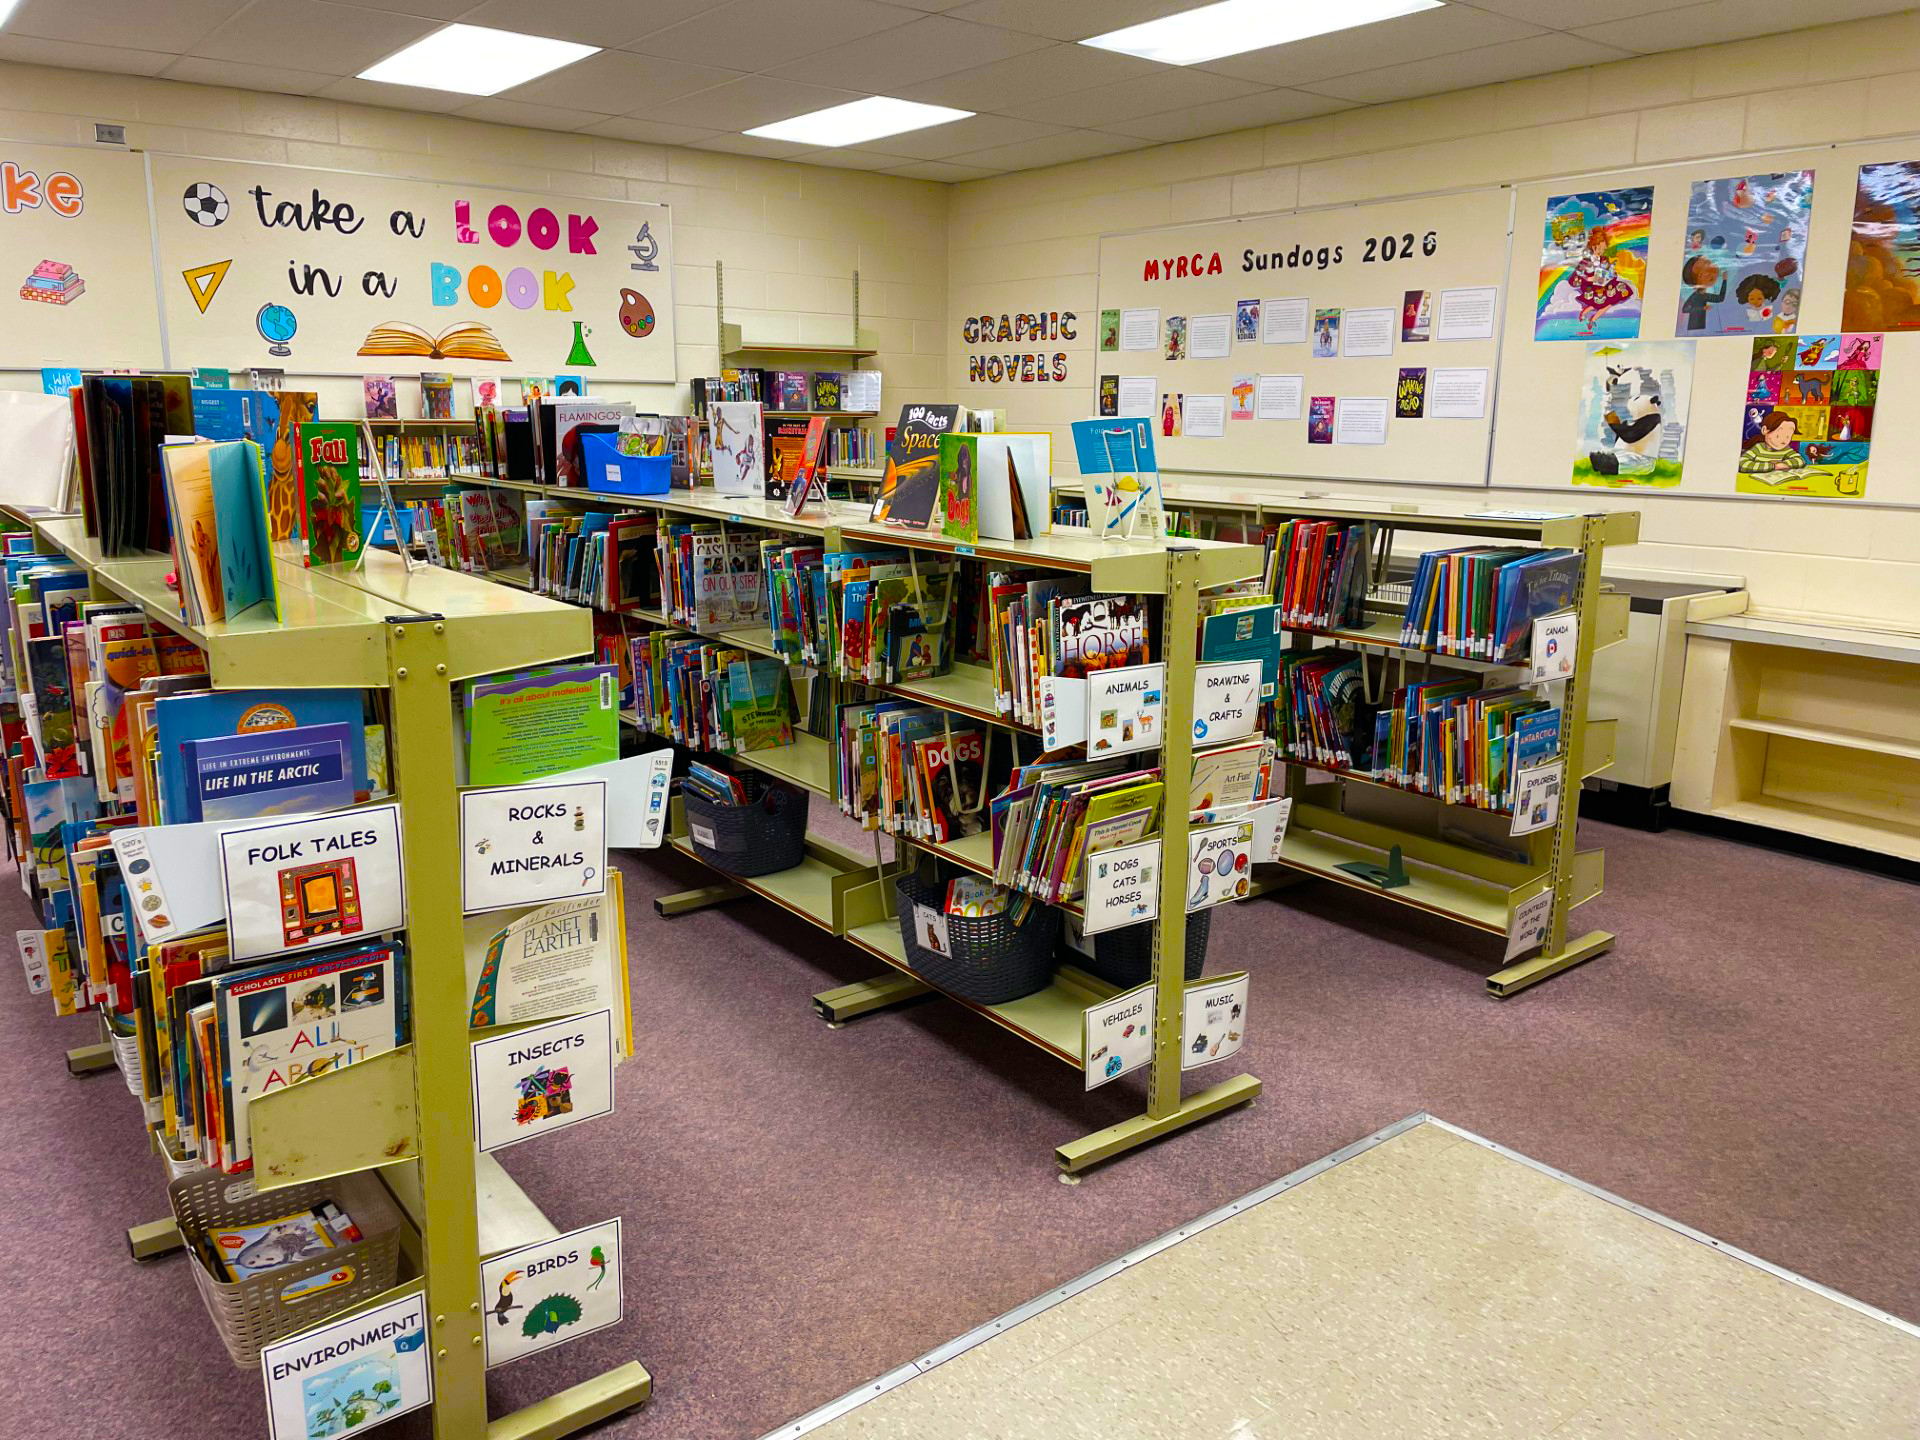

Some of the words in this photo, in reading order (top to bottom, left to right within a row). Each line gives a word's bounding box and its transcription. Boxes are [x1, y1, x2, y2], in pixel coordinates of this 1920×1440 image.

[249, 183, 364, 236] take
[390, 205, 426, 239] a
[455, 200, 600, 255] LOOK
[1144, 252, 1223, 281] MYRCA
[1243, 240, 1344, 274] Sundogs
[1363, 231, 1438, 263] 2026
[288, 258, 342, 298] in
[363, 265, 397, 298] a
[431, 262, 575, 312] BOOK
[964, 311, 1078, 344] GRAPHIC
[969, 352, 1068, 383] NOVELS
[52, 372, 73, 385] WAR
[367, 381, 393, 390] SHURI
[48, 383, 69, 396] STOR
[559, 411, 622, 422] FLAMINGOS
[909, 407, 925, 420] 100
[926, 411, 948, 428] facts
[901, 425, 940, 454] Space
[309, 436, 349, 464] Fall
[947, 488, 970, 529] Dogs
[702, 577, 716, 592] ON
[719, 575, 737, 591] OUR
[1073, 594, 1102, 603] EYEWITNESS
[1546, 626, 1568, 636] CANADA
[1063, 626, 1142, 665] HORSE
[137, 655, 203, 672] scence
[1106, 680, 1149, 695] ANIMALS
[1207, 674, 1250, 688] DRAWING
[514, 696, 523, 704] all
[526, 692, 550, 702] about
[1225, 693, 1231, 703] &
[1209, 709, 1243, 722] CRAFTS
[1520, 728, 1556, 744] ANTARCTICA
[203, 762, 216, 771] LIFE
[230, 756, 259, 767] EXTREME
[261, 749, 311, 763] ENVIRONMENTS
[928, 740, 981, 768] DOGS
[205, 776, 229, 791] LIFE
[233, 774, 247, 787] IN
[251, 770, 274, 784] THE
[277, 763, 320, 780] ARCTIC
[1224, 775, 1235, 783] Art
[1527, 774, 1557, 788] EXPLORERS
[508, 804, 567, 822] ROCKS
[532, 830, 544, 845] &
[1207, 836, 1237, 851] SPORTS
[248, 842, 303, 865] FOLK
[310, 830, 378, 853] TALES
[490, 852, 584, 876] MINERALS
[1113, 858, 1139, 872] DOGS
[1112, 876, 1137, 889] CATS
[965, 890, 984, 899] Book
[1105, 891, 1142, 908] HORSES
[545, 898, 600, 917] Factfinder
[1519, 900, 1548, 920] COUNTRIES
[923, 912, 937, 922] CATS
[1522, 920, 1528, 929] OF
[1530, 914, 1541, 924] THE
[524, 915, 582, 944] PLANET
[1520, 927, 1537, 941] WORLD
[522, 928, 582, 959] EARTH
[233, 976, 285, 993] SCHOLASTIC
[288, 968, 314, 981] FIRST
[317, 953, 386, 974] ENCYCLOPEDIA
[1205, 994, 1234, 1008] MUSIC
[1102, 1003, 1143, 1028] VEHICLES
[508, 1033, 585, 1067] INSECTS
[527, 1250, 579, 1278] BIRDS
[272, 1312, 419, 1381] ENVIRONMENT
